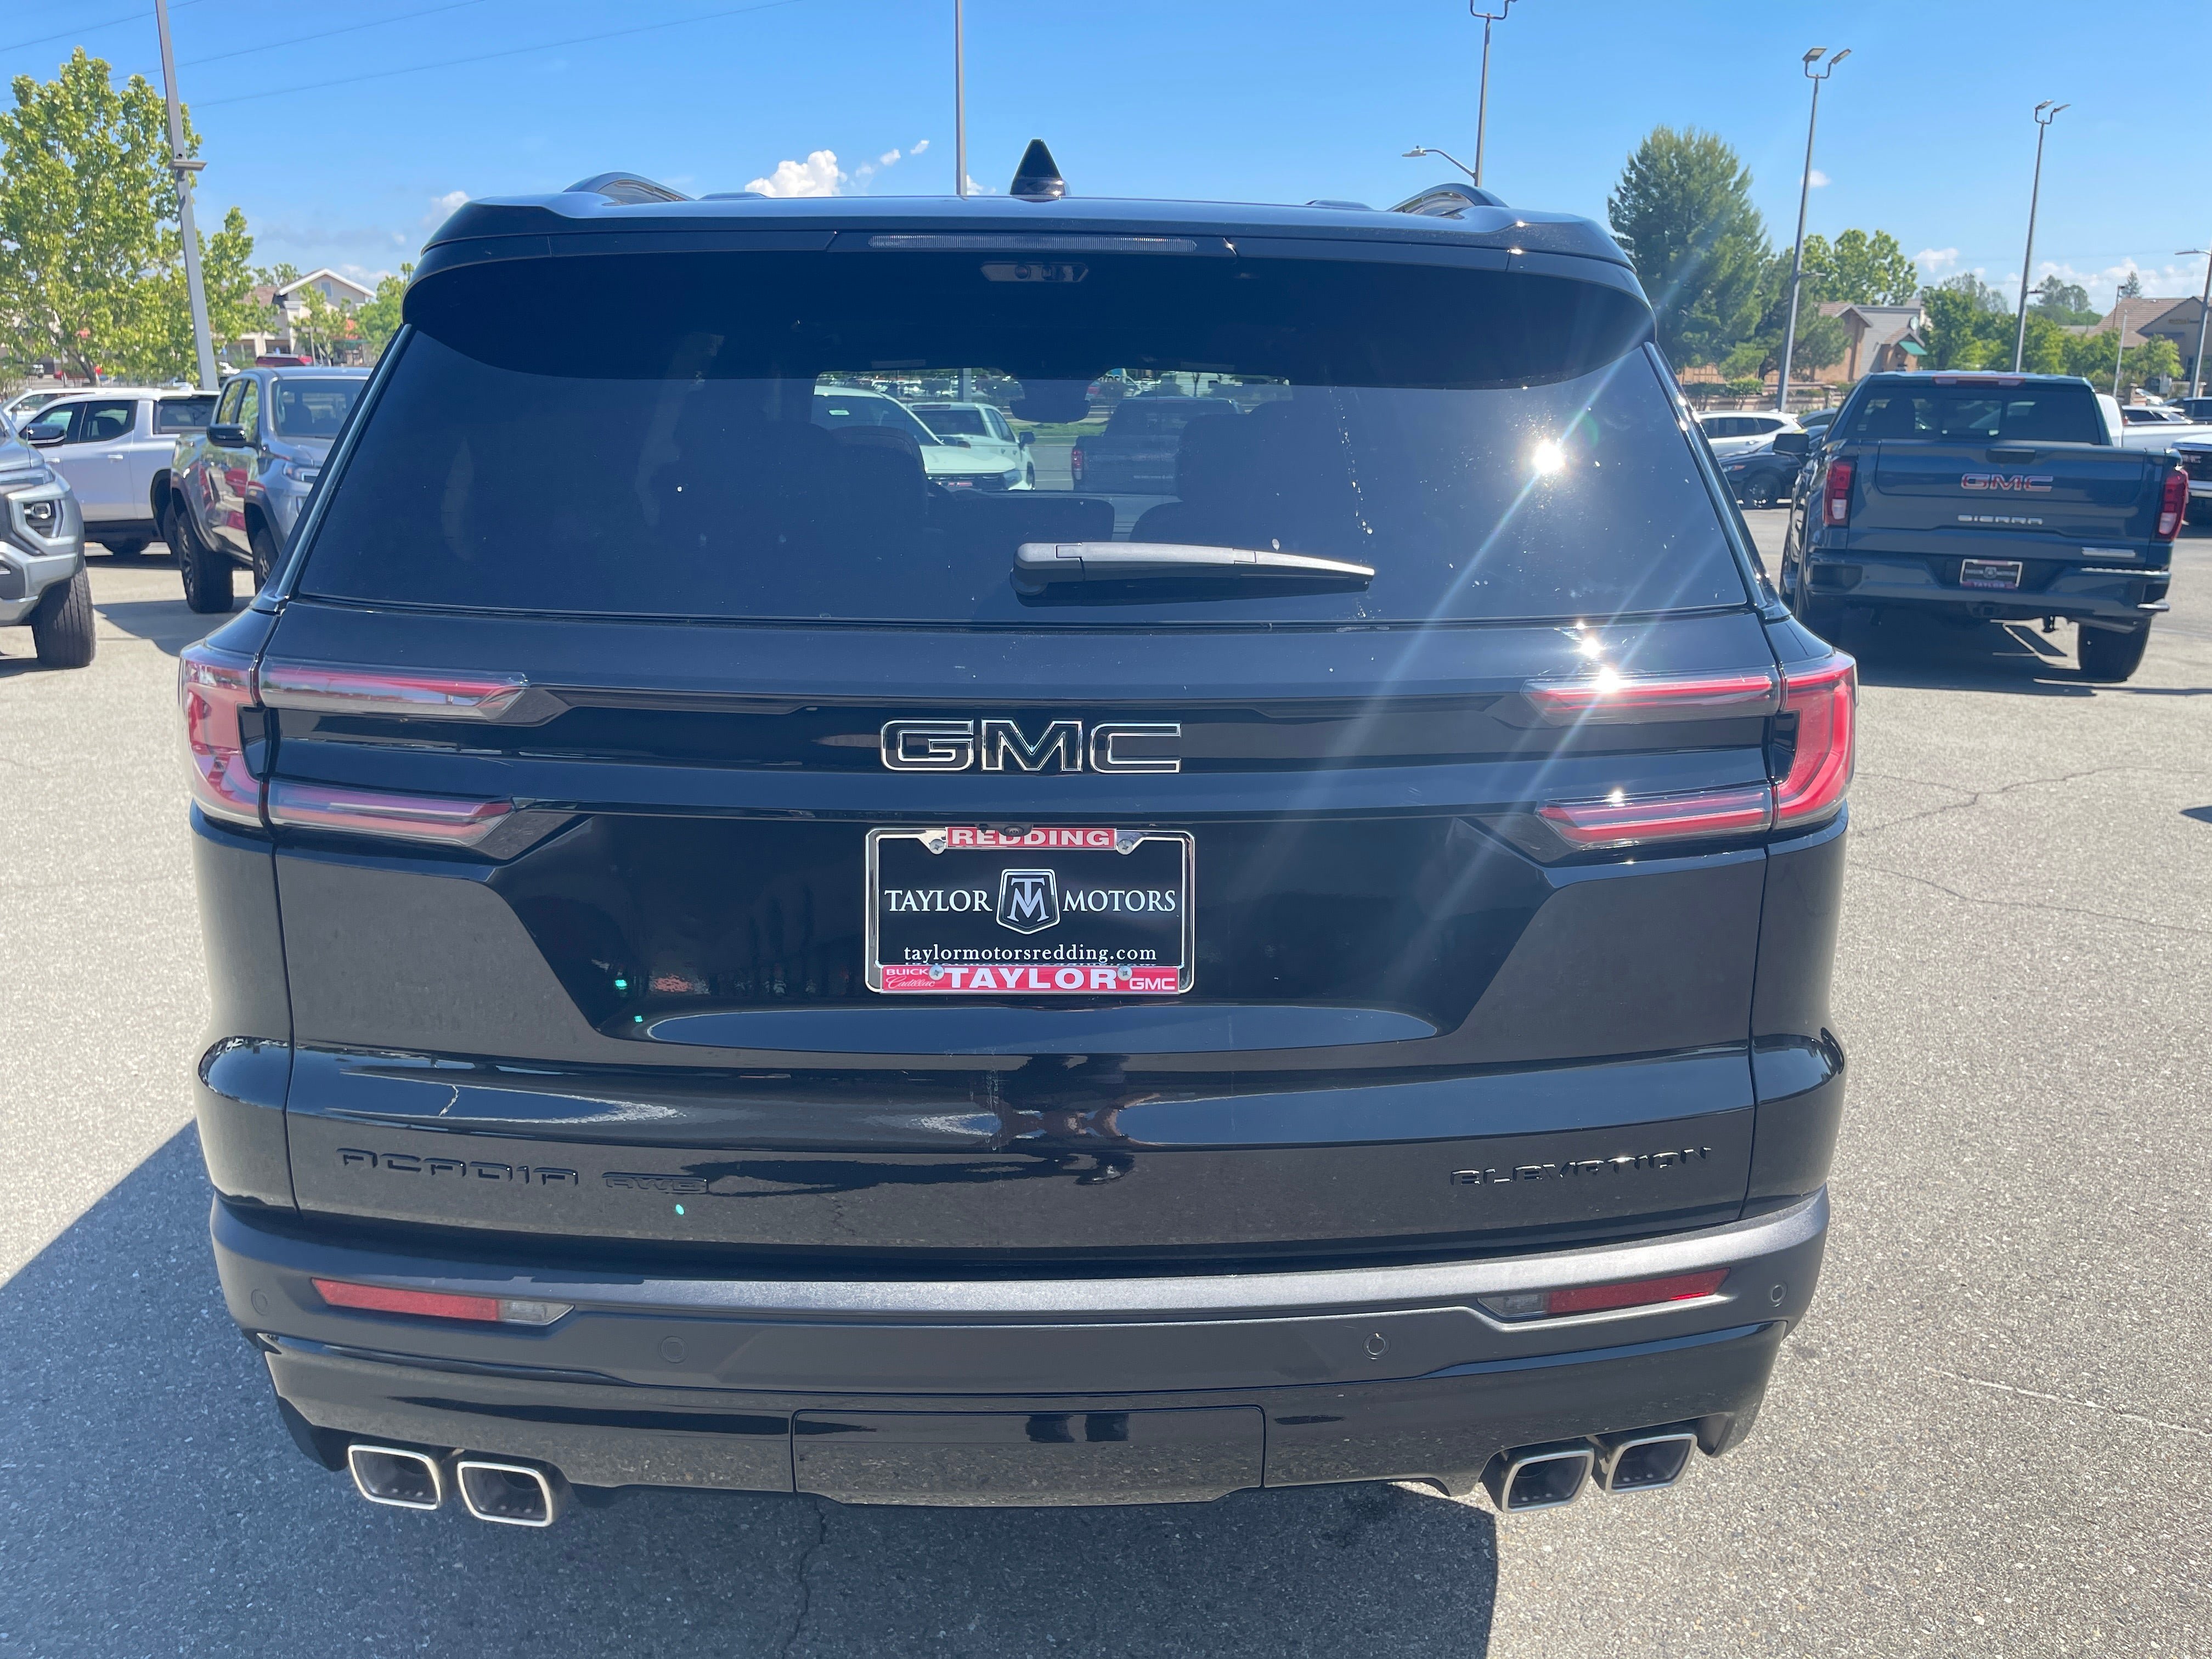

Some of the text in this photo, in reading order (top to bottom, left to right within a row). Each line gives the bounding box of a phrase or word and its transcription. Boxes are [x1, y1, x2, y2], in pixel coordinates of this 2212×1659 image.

[1961, 473, 2053, 492] GMC
[1957, 515, 2043, 525] SIERRA
[881, 718, 1182, 773] GMC
[884, 890, 1176, 912] TAYLOR MOTORS
[904, 944, 1156, 963] taylormotorsredding.com
[885, 975, 935, 989] Cadillac
[944, 968, 1117, 990] TAYLOR
[1129, 978, 1175, 990] GMC
[335, 1148, 579, 1186] ACADIA
[1450, 1146, 1712, 1186] ELEVATION
[603, 1173, 707, 1194] AWD
